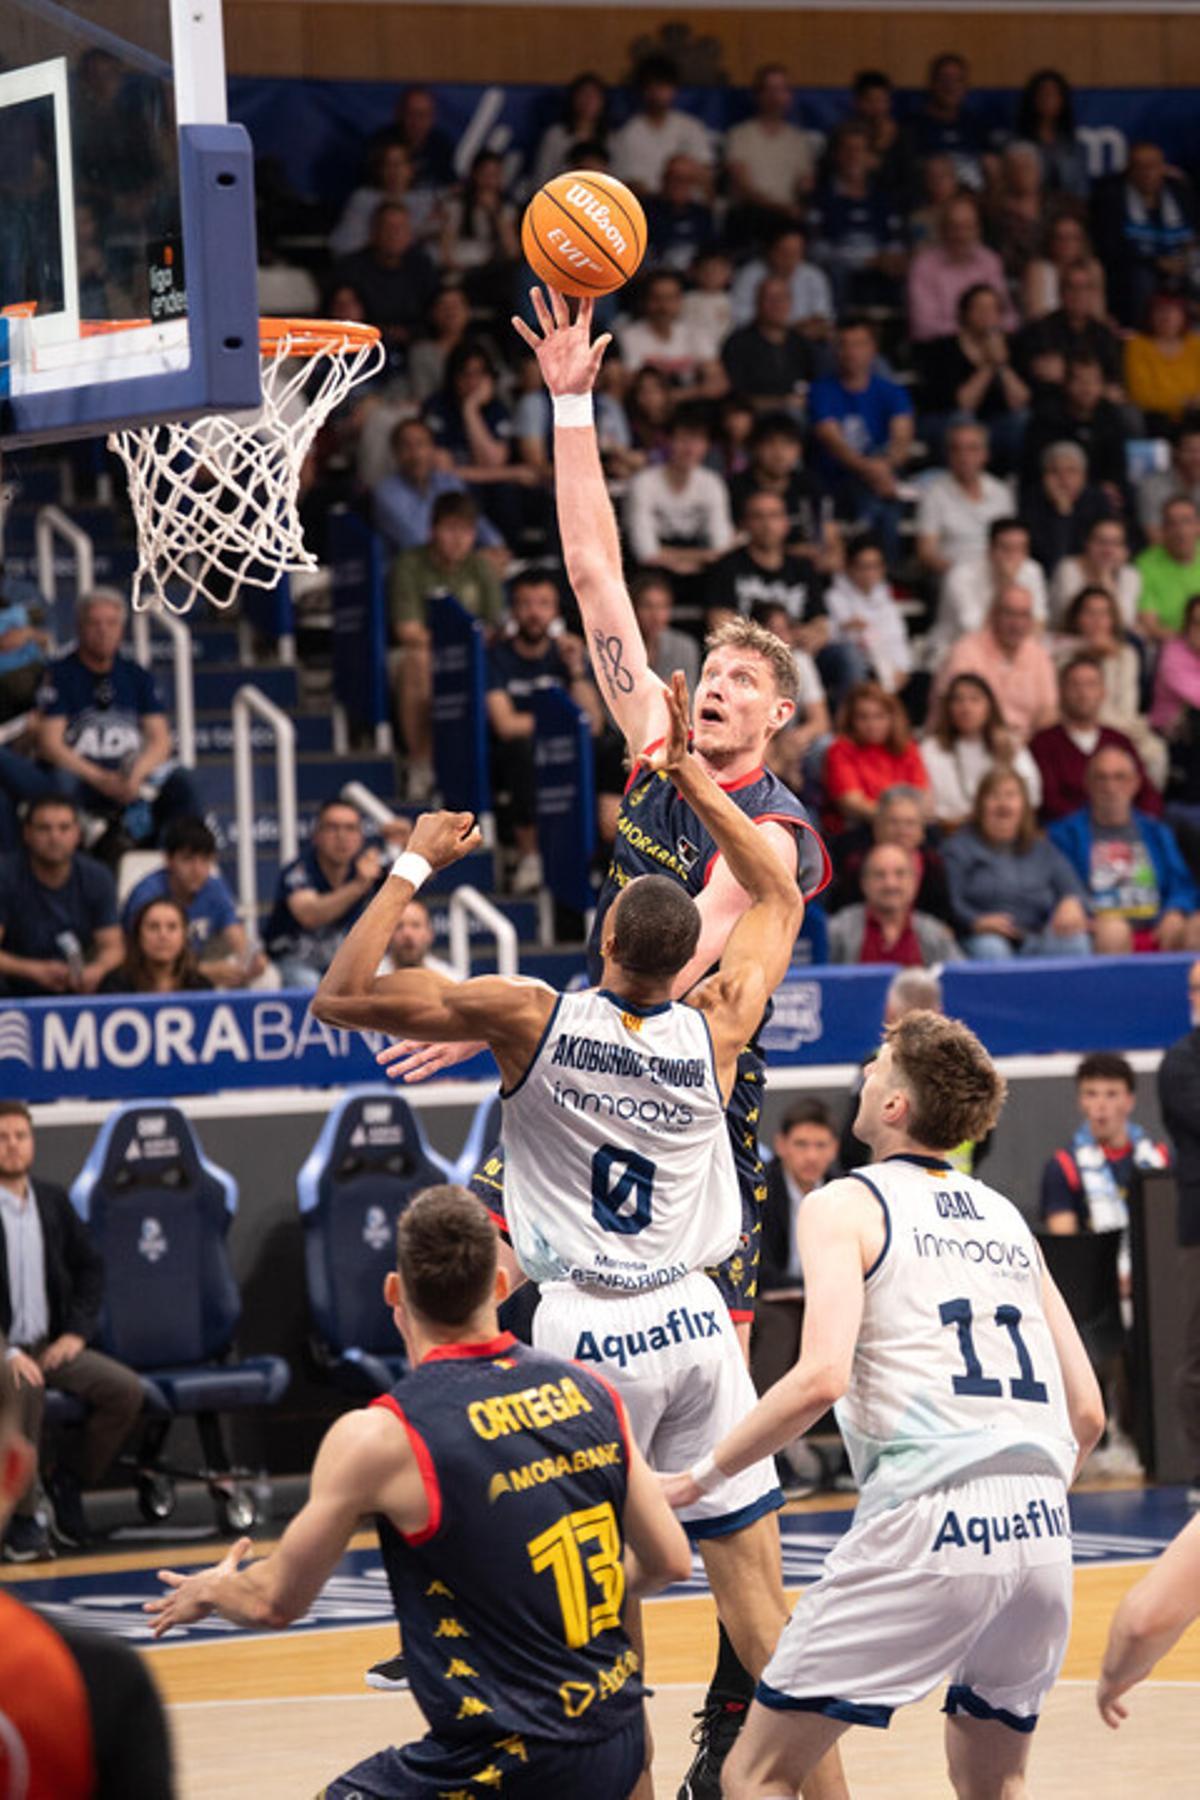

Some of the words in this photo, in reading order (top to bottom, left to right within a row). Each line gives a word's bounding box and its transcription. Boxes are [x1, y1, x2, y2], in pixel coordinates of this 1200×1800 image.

[565, 184, 628, 256] Wilson
[42, 1001, 404, 1071] MORABAN
[591, 1143, 657, 1235] 0
[573, 1306, 722, 1367] Aquaflix
[938, 1297, 1050, 1405] 11
[467, 1376, 593, 1440] ORTEGA
[526, 1501, 625, 1650] 13
